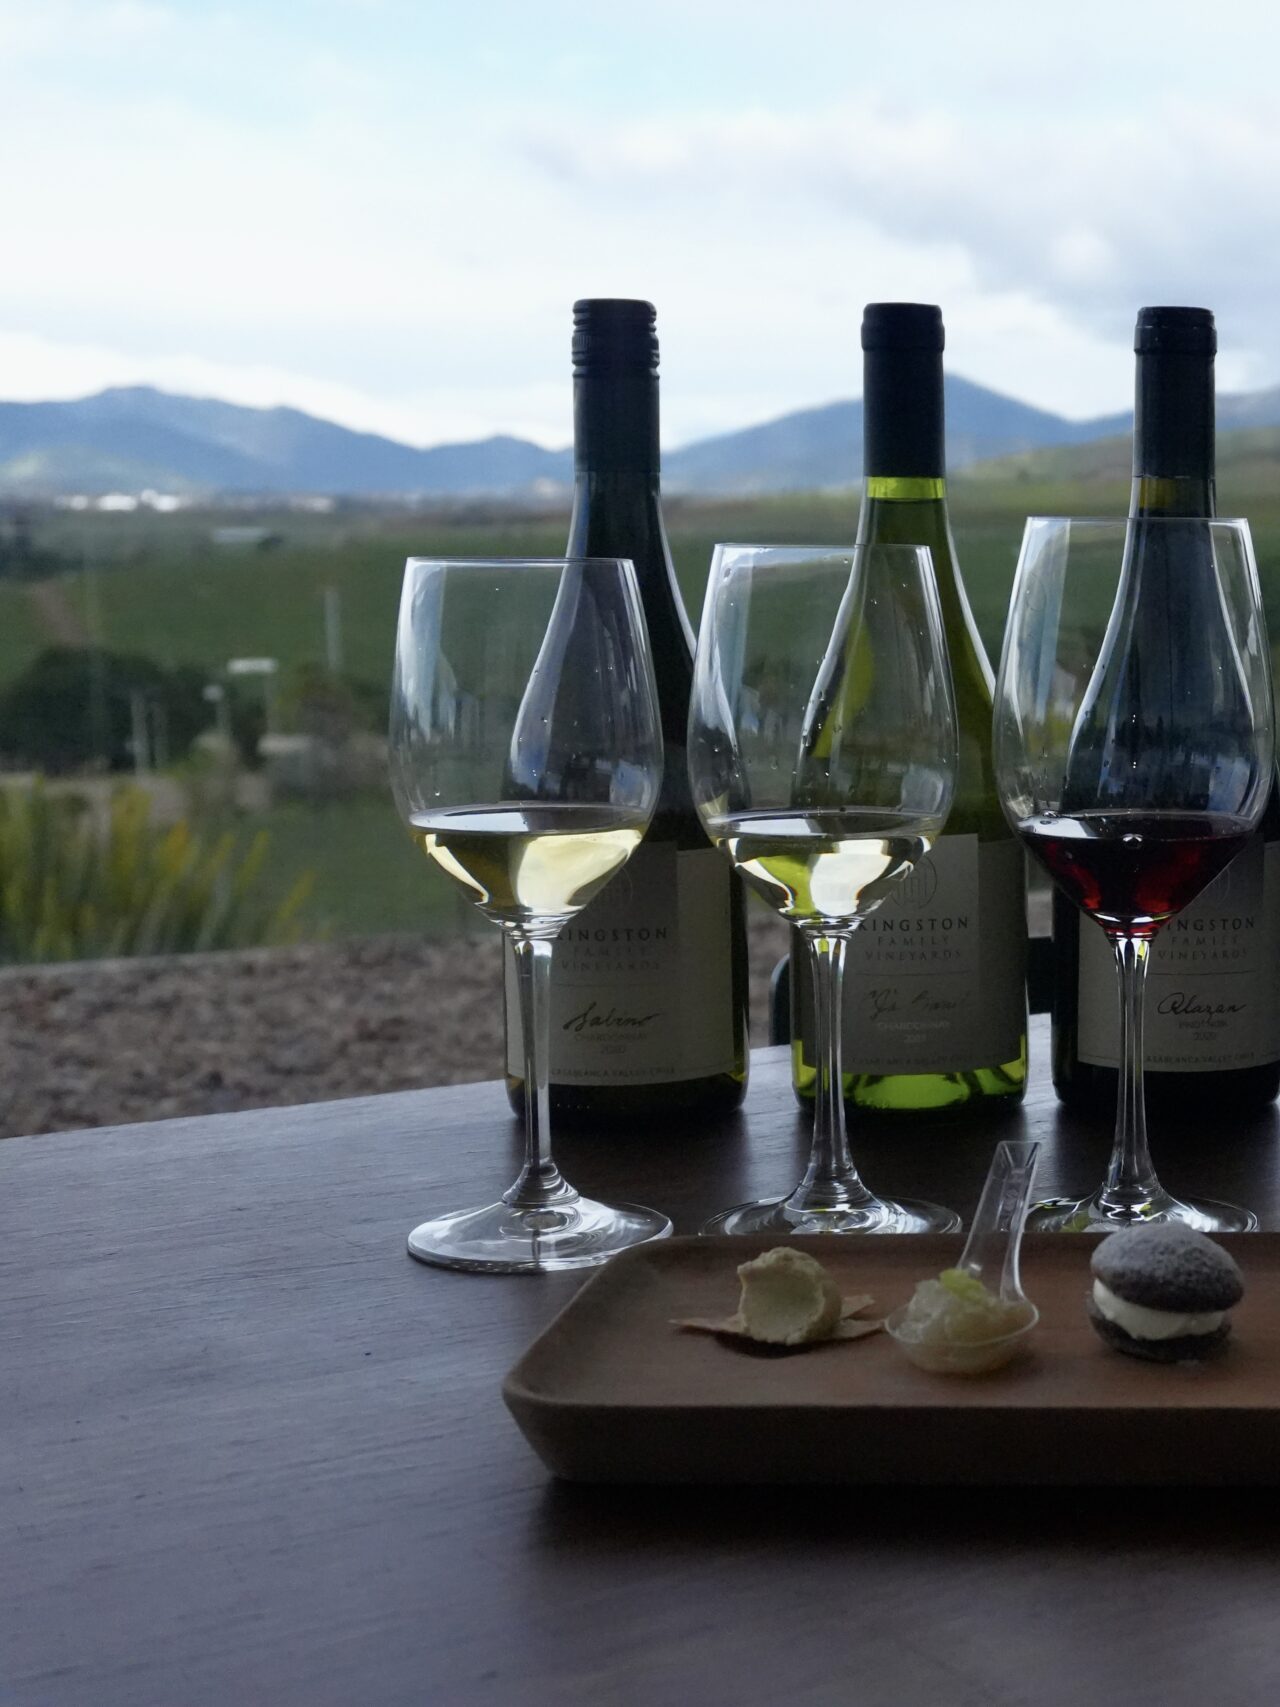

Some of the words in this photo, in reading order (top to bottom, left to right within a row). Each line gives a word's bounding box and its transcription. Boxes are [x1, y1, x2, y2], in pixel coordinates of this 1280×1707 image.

[1166, 916, 1256, 931] INGSTON
[878, 935, 949, 946] FAMILY
[864, 949, 961, 961] VINEYARDS
[1158, 948, 1247, 960] VINEYARDS
